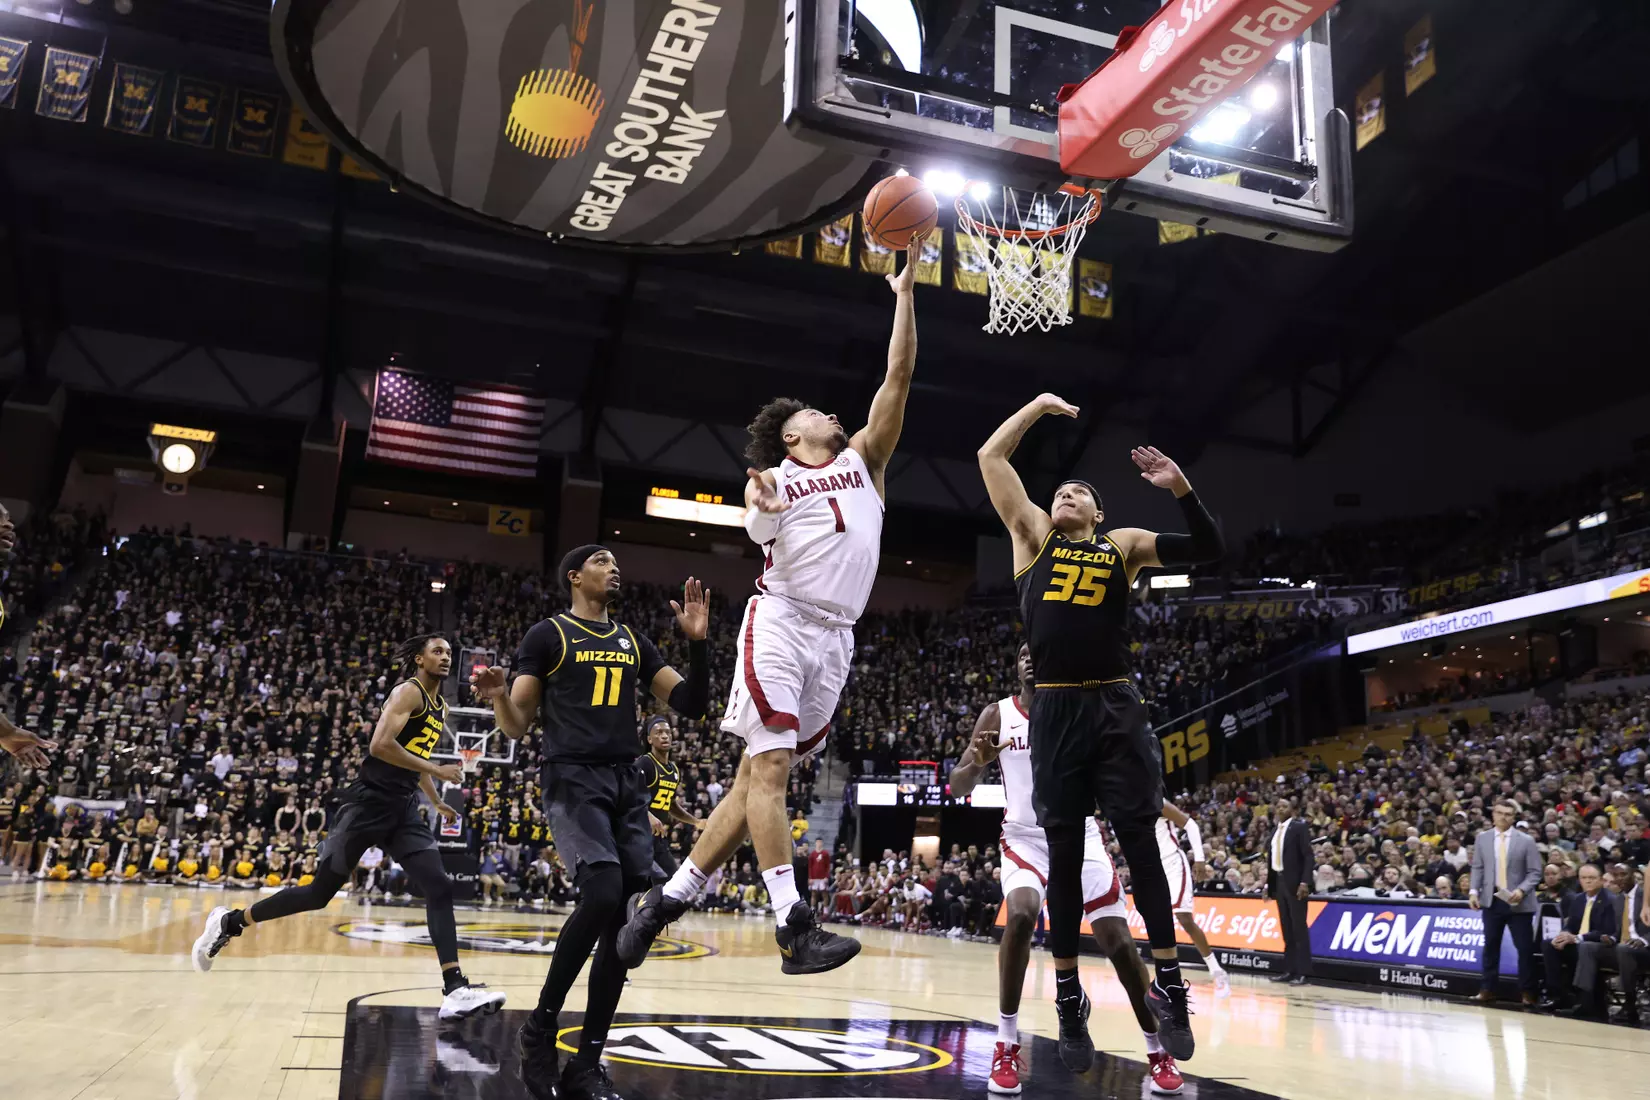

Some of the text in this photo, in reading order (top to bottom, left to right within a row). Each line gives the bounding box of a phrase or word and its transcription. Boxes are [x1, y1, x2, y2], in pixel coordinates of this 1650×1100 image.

[643, 101, 727, 185] BANK
[569, 161, 637, 232] GREAT
[784, 470, 865, 502] ALABAMA
[495, 510, 524, 534] ZC
[827, 497, 846, 533] 1
[1051, 547, 1116, 566] MIZZOU
[1042, 563, 1112, 607] 35
[1400, 609, 1494, 642] weichert.com
[575, 650, 635, 665] MIZZOU
[591, 666, 624, 707] 11
[404, 726, 440, 760] 23
[1160, 719, 1210, 774] RS
[650, 789, 675, 811] 55
[1227, 908, 1280, 944] safe.
[1434, 915, 1485, 931] MISSOU
[1229, 953, 1252, 967] Health
[1252, 956, 1270, 969] Care
[1426, 946, 1477, 962] MUTUAL
[1391, 969, 1423, 986] Health
[1424, 973, 1449, 990] Care
